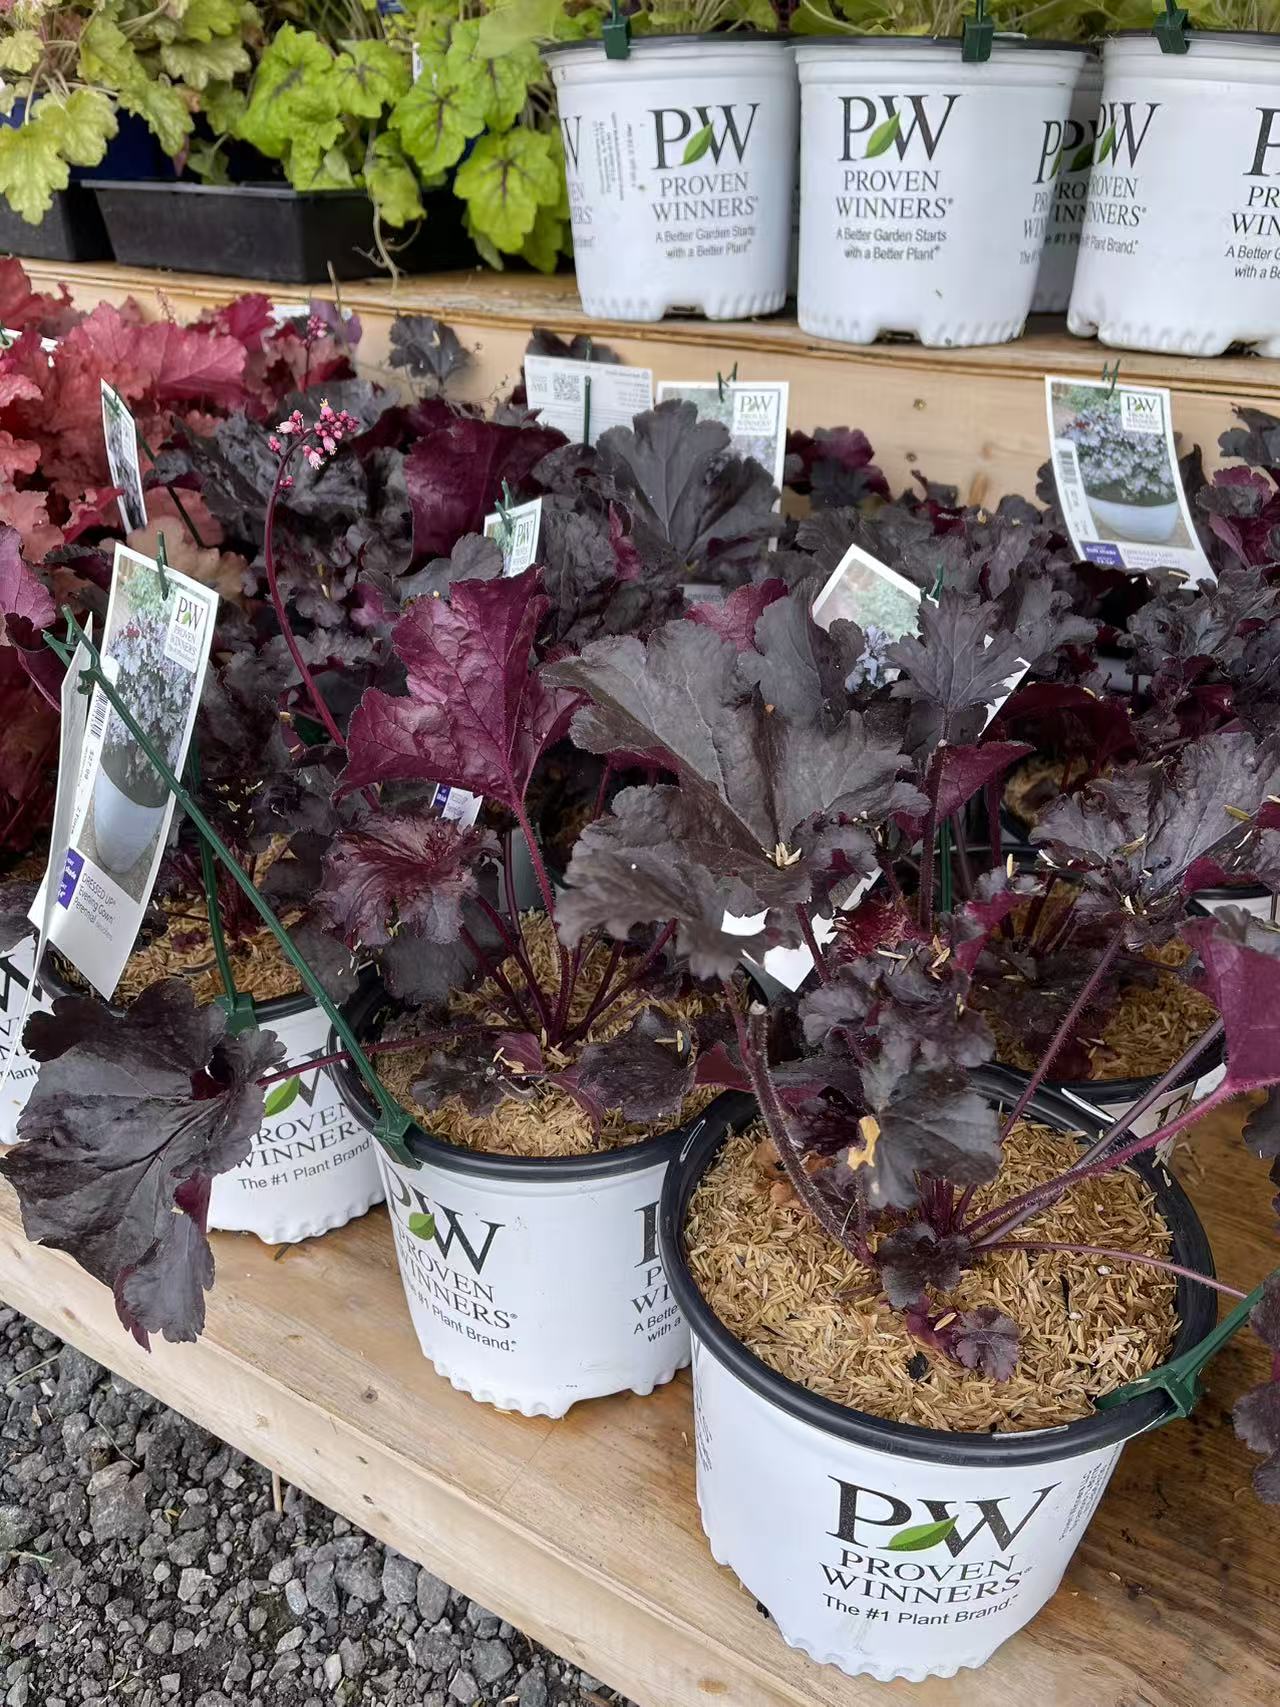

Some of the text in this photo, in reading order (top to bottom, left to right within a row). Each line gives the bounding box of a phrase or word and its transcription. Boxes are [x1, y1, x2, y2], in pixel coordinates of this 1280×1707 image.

[648, 103, 760, 169] PW
[838, 94, 961, 162] PW
[660, 172, 749, 196] PROVEN
[844, 170, 941, 191] PROVEN
[656, 232, 663, 243] A
[664, 230, 693, 242] Better
[696, 228, 730, 240] Garden
[836, 227, 947, 241] A Better Garden Starts
[666, 246, 686, 258] with
[696, 245, 724, 257] Better
[844, 245, 862, 258] with
[865, 249, 871, 259] a
[873, 247, 904, 259] Better
[1224, 245, 1234, 258] A
[1238, 244, 1272, 259] Better
[1235, 264, 1257, 278] with
[1260, 268, 1267, 278] a
[740, 395, 773, 412] PW
[1126, 396, 1157, 412] PW
[175, 596, 204, 630] PW
[82, 873, 105, 900] DRESSED
[73, 897, 97, 923] Perennial
[79, 885, 99, 912] Evening
[98, 904, 114, 924] Gown
[256, 1102, 347, 1146] ROVE
[236, 1121, 363, 1169] WINNER
[238, 1177, 267, 1190] The
[272, 1172, 288, 1186] #1
[293, 1160, 330, 1180] Plant
[384, 1162, 505, 1276] PW
[398, 1222, 494, 1304] PROVEN
[432, 1304, 463, 1334] Plant
[633, 1322, 644, 1334] A
[648, 1317, 681, 1342] with a
[825, 1475, 1063, 1558] PW
[839, 1547, 1019, 1582] PROVEN
[822, 1593, 860, 1616] The
[866, 1607, 889, 1622] #1
[898, 1612, 950, 1625] Plant
